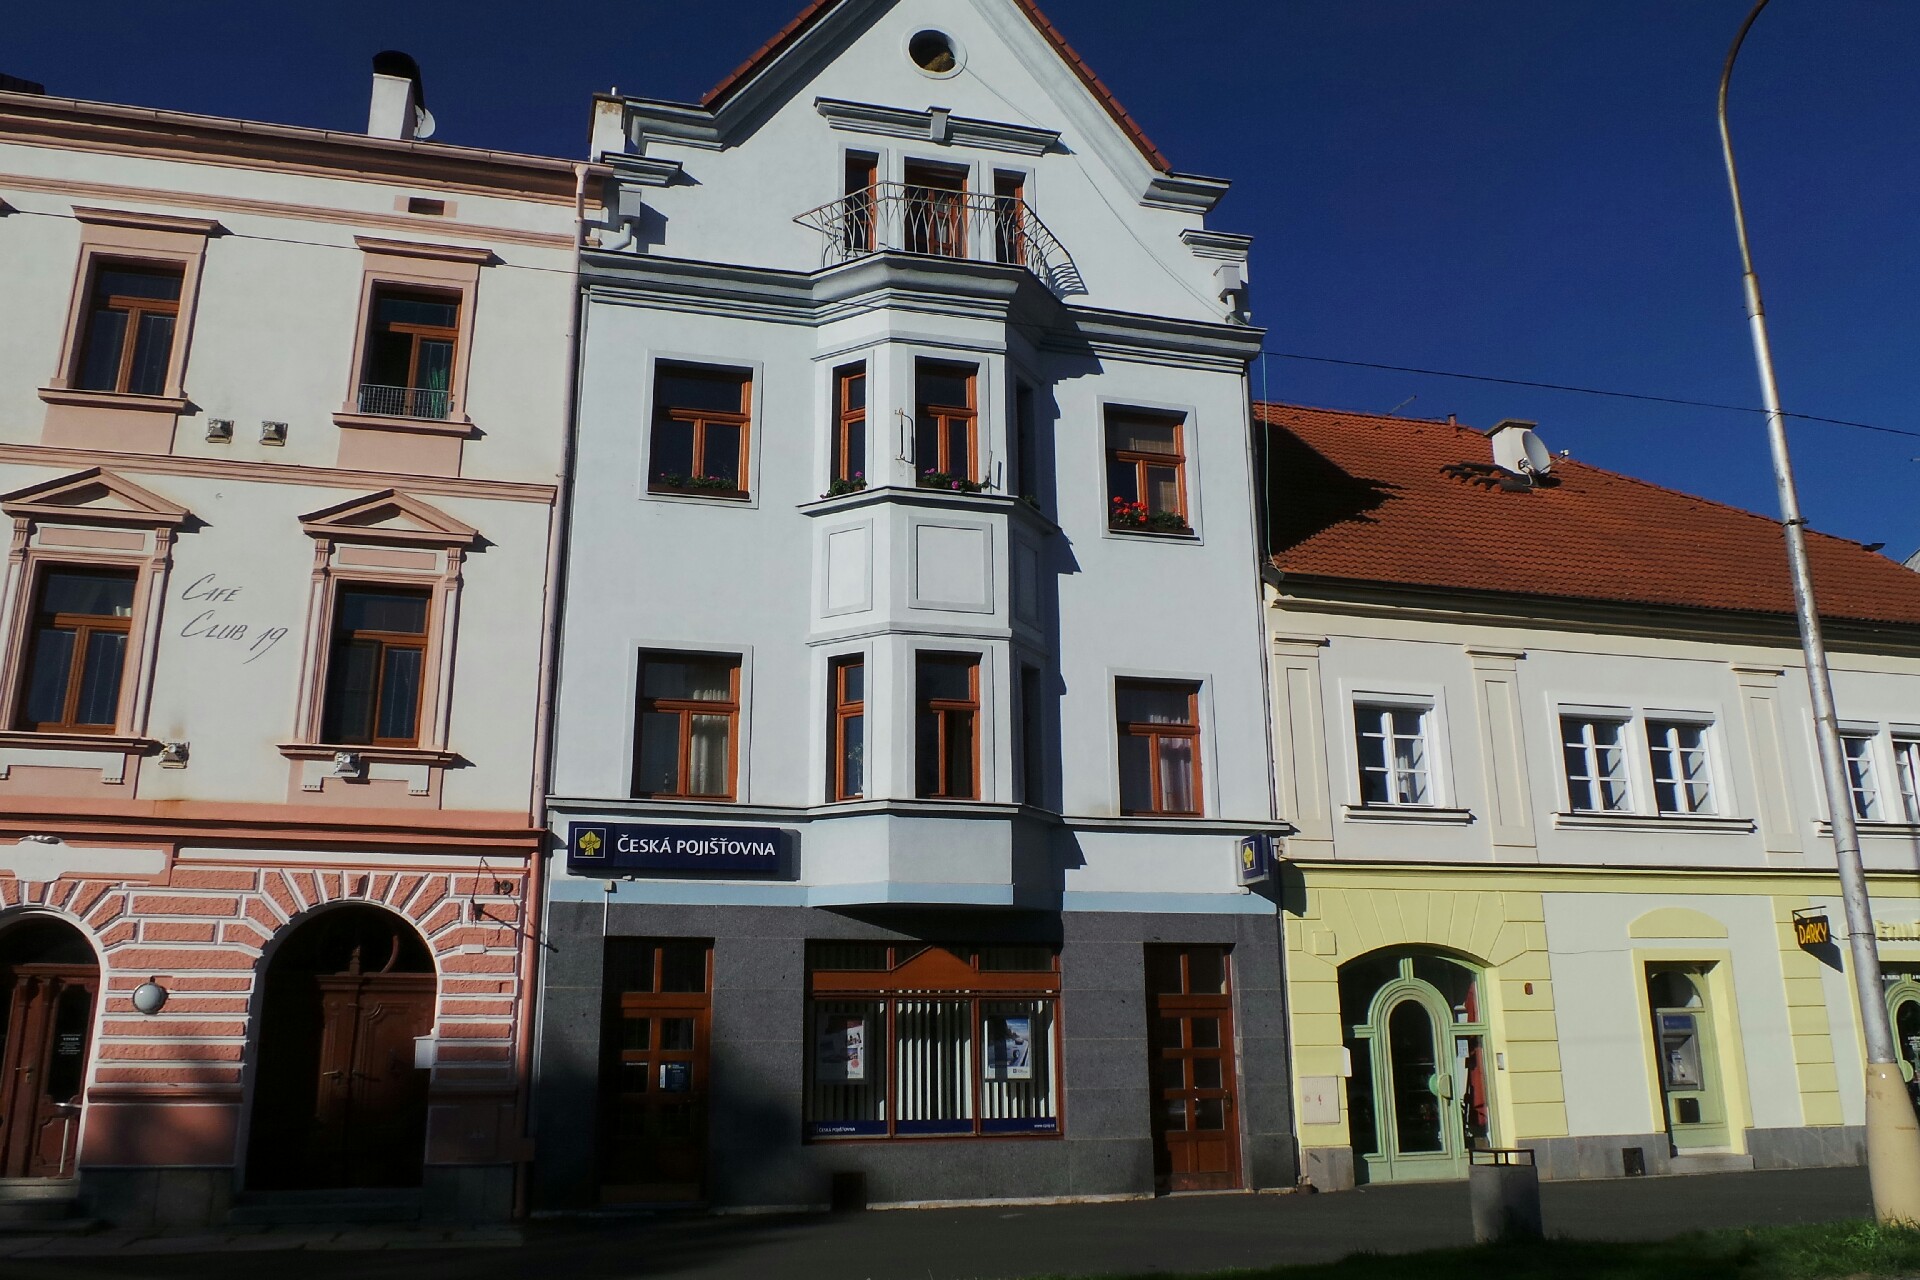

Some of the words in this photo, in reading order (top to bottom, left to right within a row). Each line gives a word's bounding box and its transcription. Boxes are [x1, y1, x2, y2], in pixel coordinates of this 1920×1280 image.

[243, 627, 289, 665] 19
[617, 833, 672, 854] ČESKÁ
[676, 837, 776, 856] POJIŠŤOVNA
[1797, 919, 1828, 945] DÁRKY
